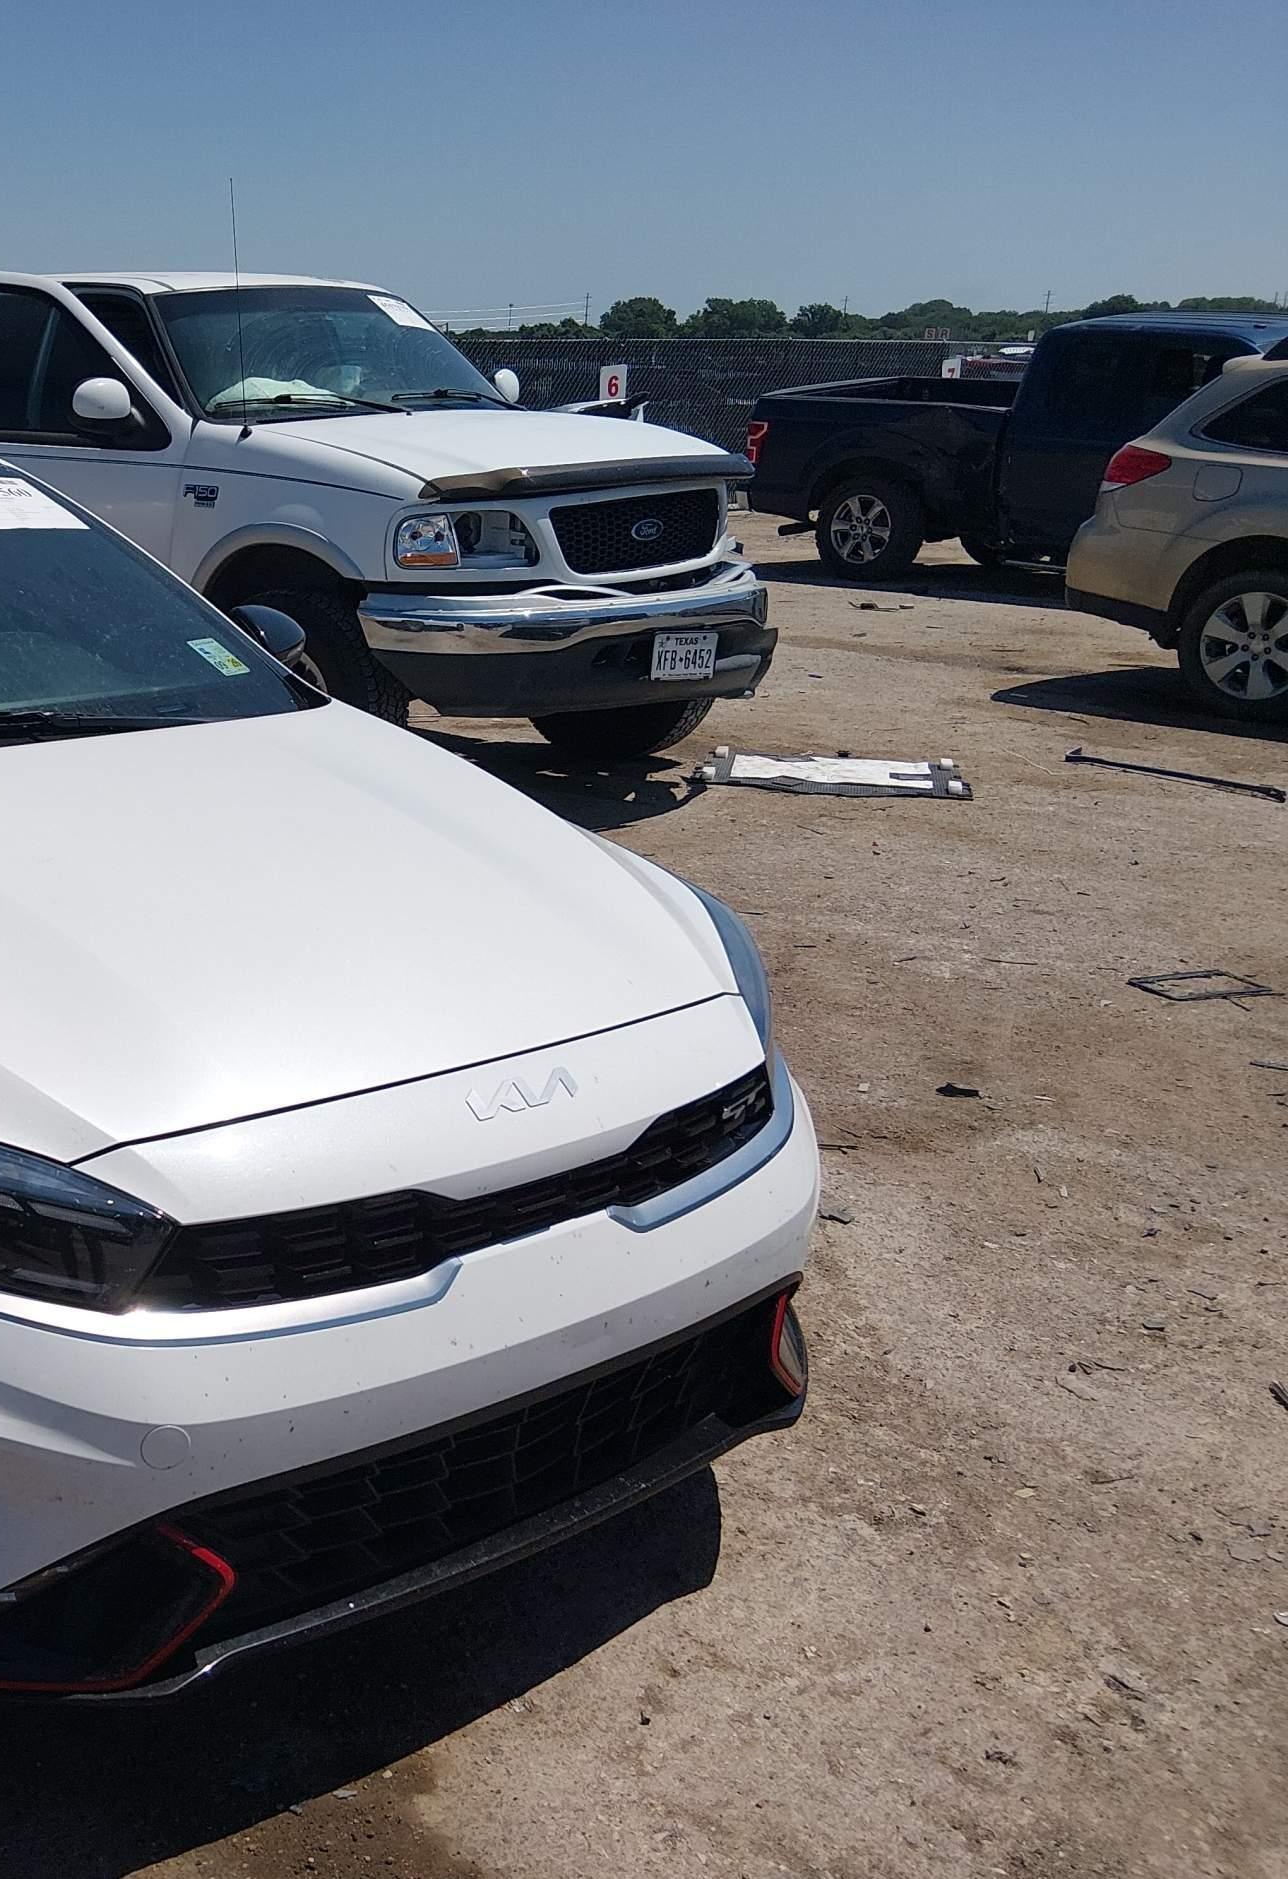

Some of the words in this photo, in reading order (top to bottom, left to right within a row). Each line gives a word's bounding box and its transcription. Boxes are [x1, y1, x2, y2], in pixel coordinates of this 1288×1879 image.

[608, 376, 619, 397] 6
[640, 523, 658, 536] Ford
[675, 637, 699, 646] TEXAS
[465, 1067, 578, 1121] KIA
